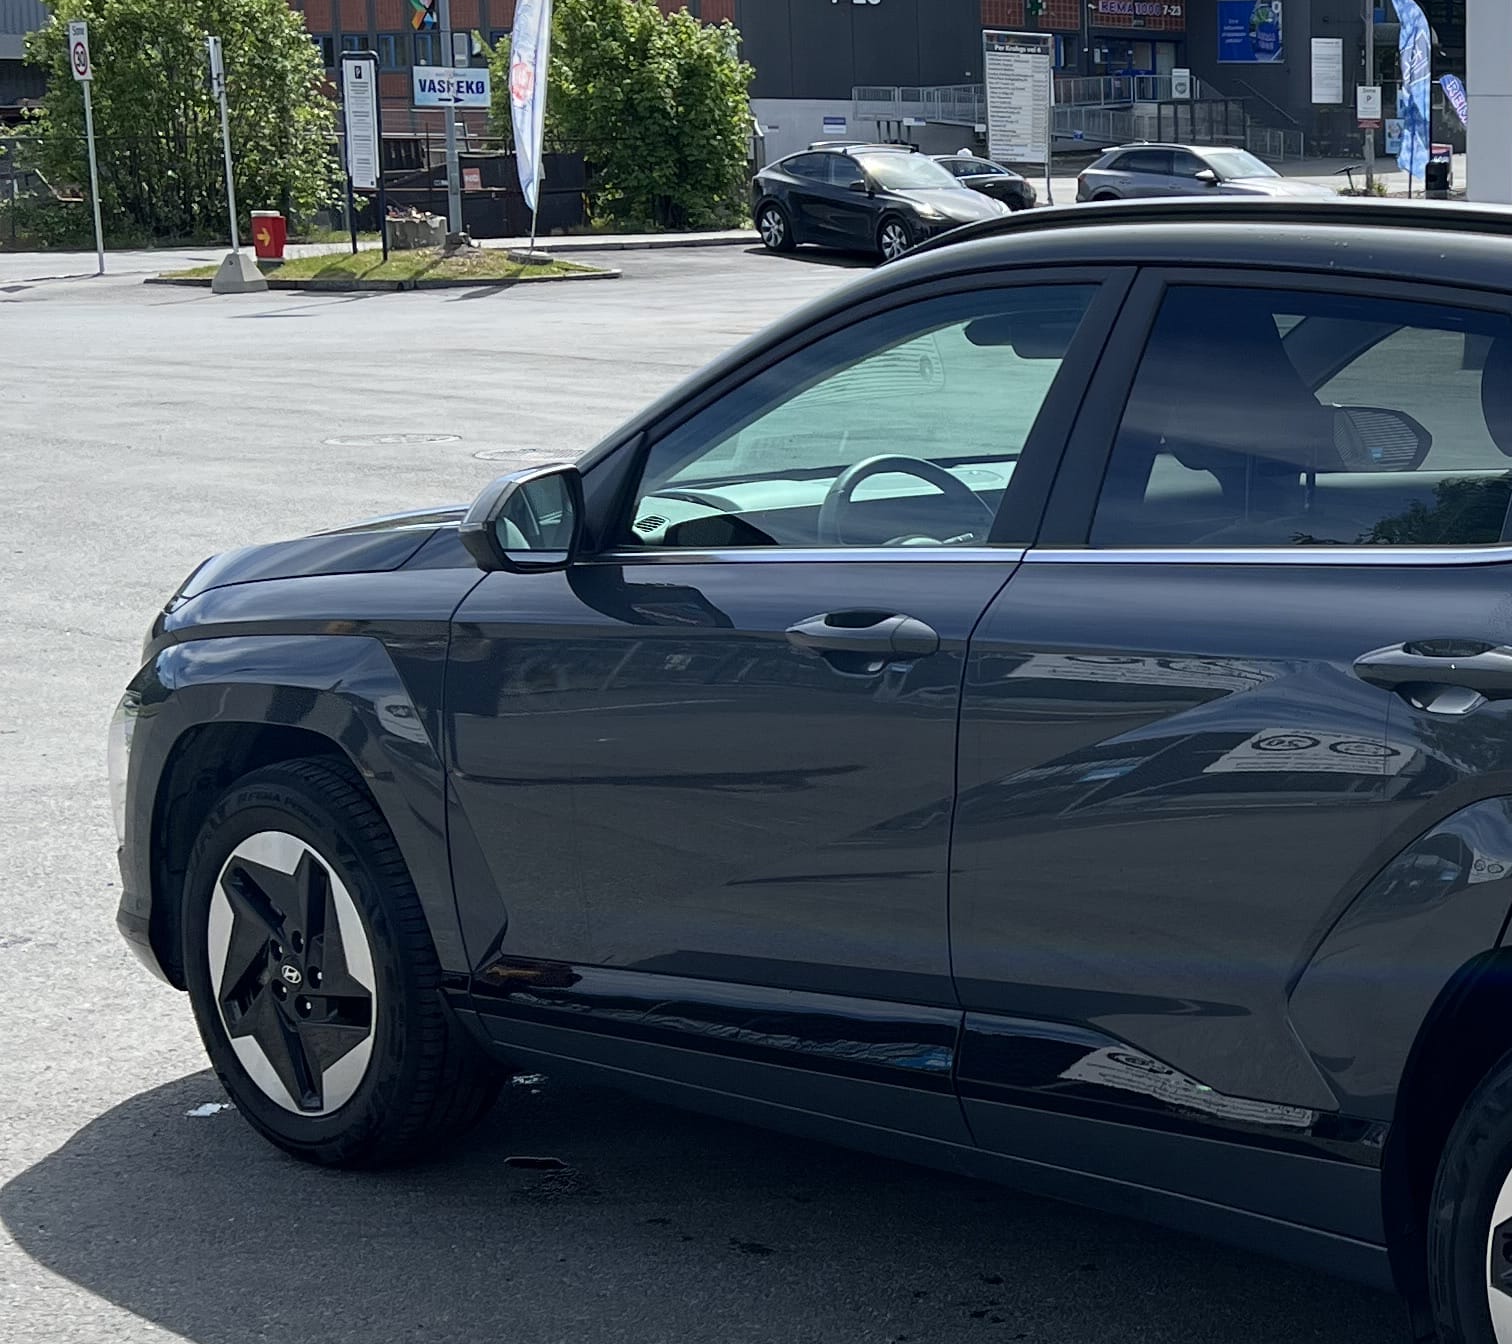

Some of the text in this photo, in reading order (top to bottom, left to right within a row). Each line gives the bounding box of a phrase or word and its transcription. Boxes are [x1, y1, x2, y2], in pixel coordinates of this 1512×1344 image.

[1098, 0, 1182, 16] REMA 1000 7-23
[1446, 79, 1468, 125] REM
